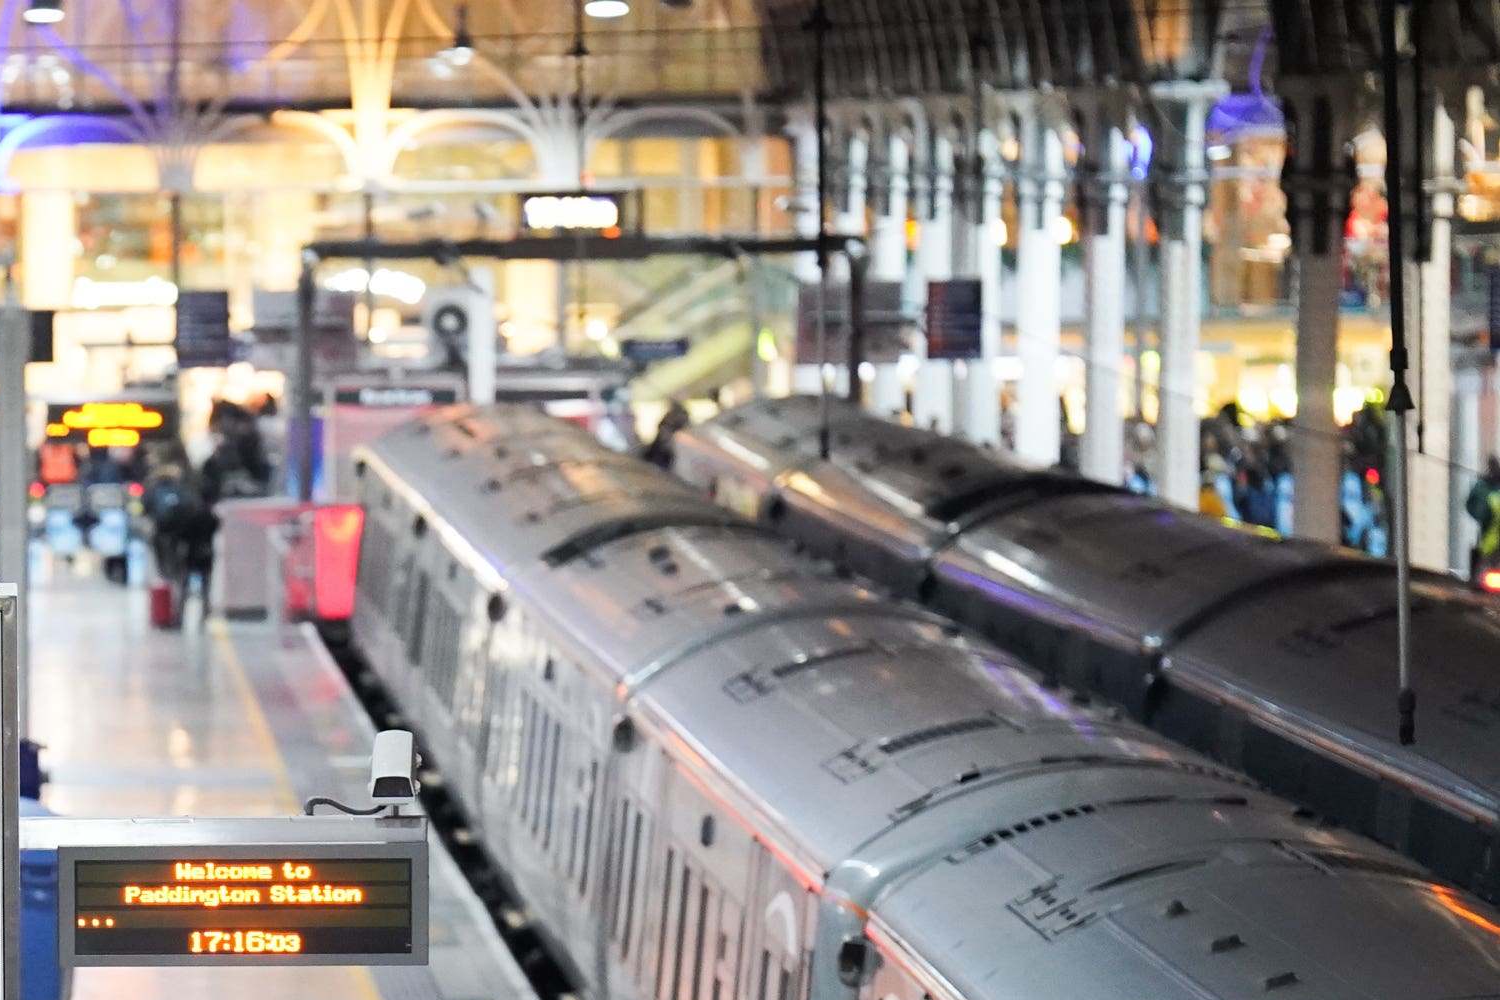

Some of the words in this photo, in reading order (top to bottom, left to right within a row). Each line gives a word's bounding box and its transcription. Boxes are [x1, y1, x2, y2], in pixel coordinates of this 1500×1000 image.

[175, 862, 273, 881] Welcome
[283, 862, 311, 880] to
[124, 885, 260, 907] Paddington
[270, 885, 362, 904] Station
[190, 930, 302, 953] 17:16:03
